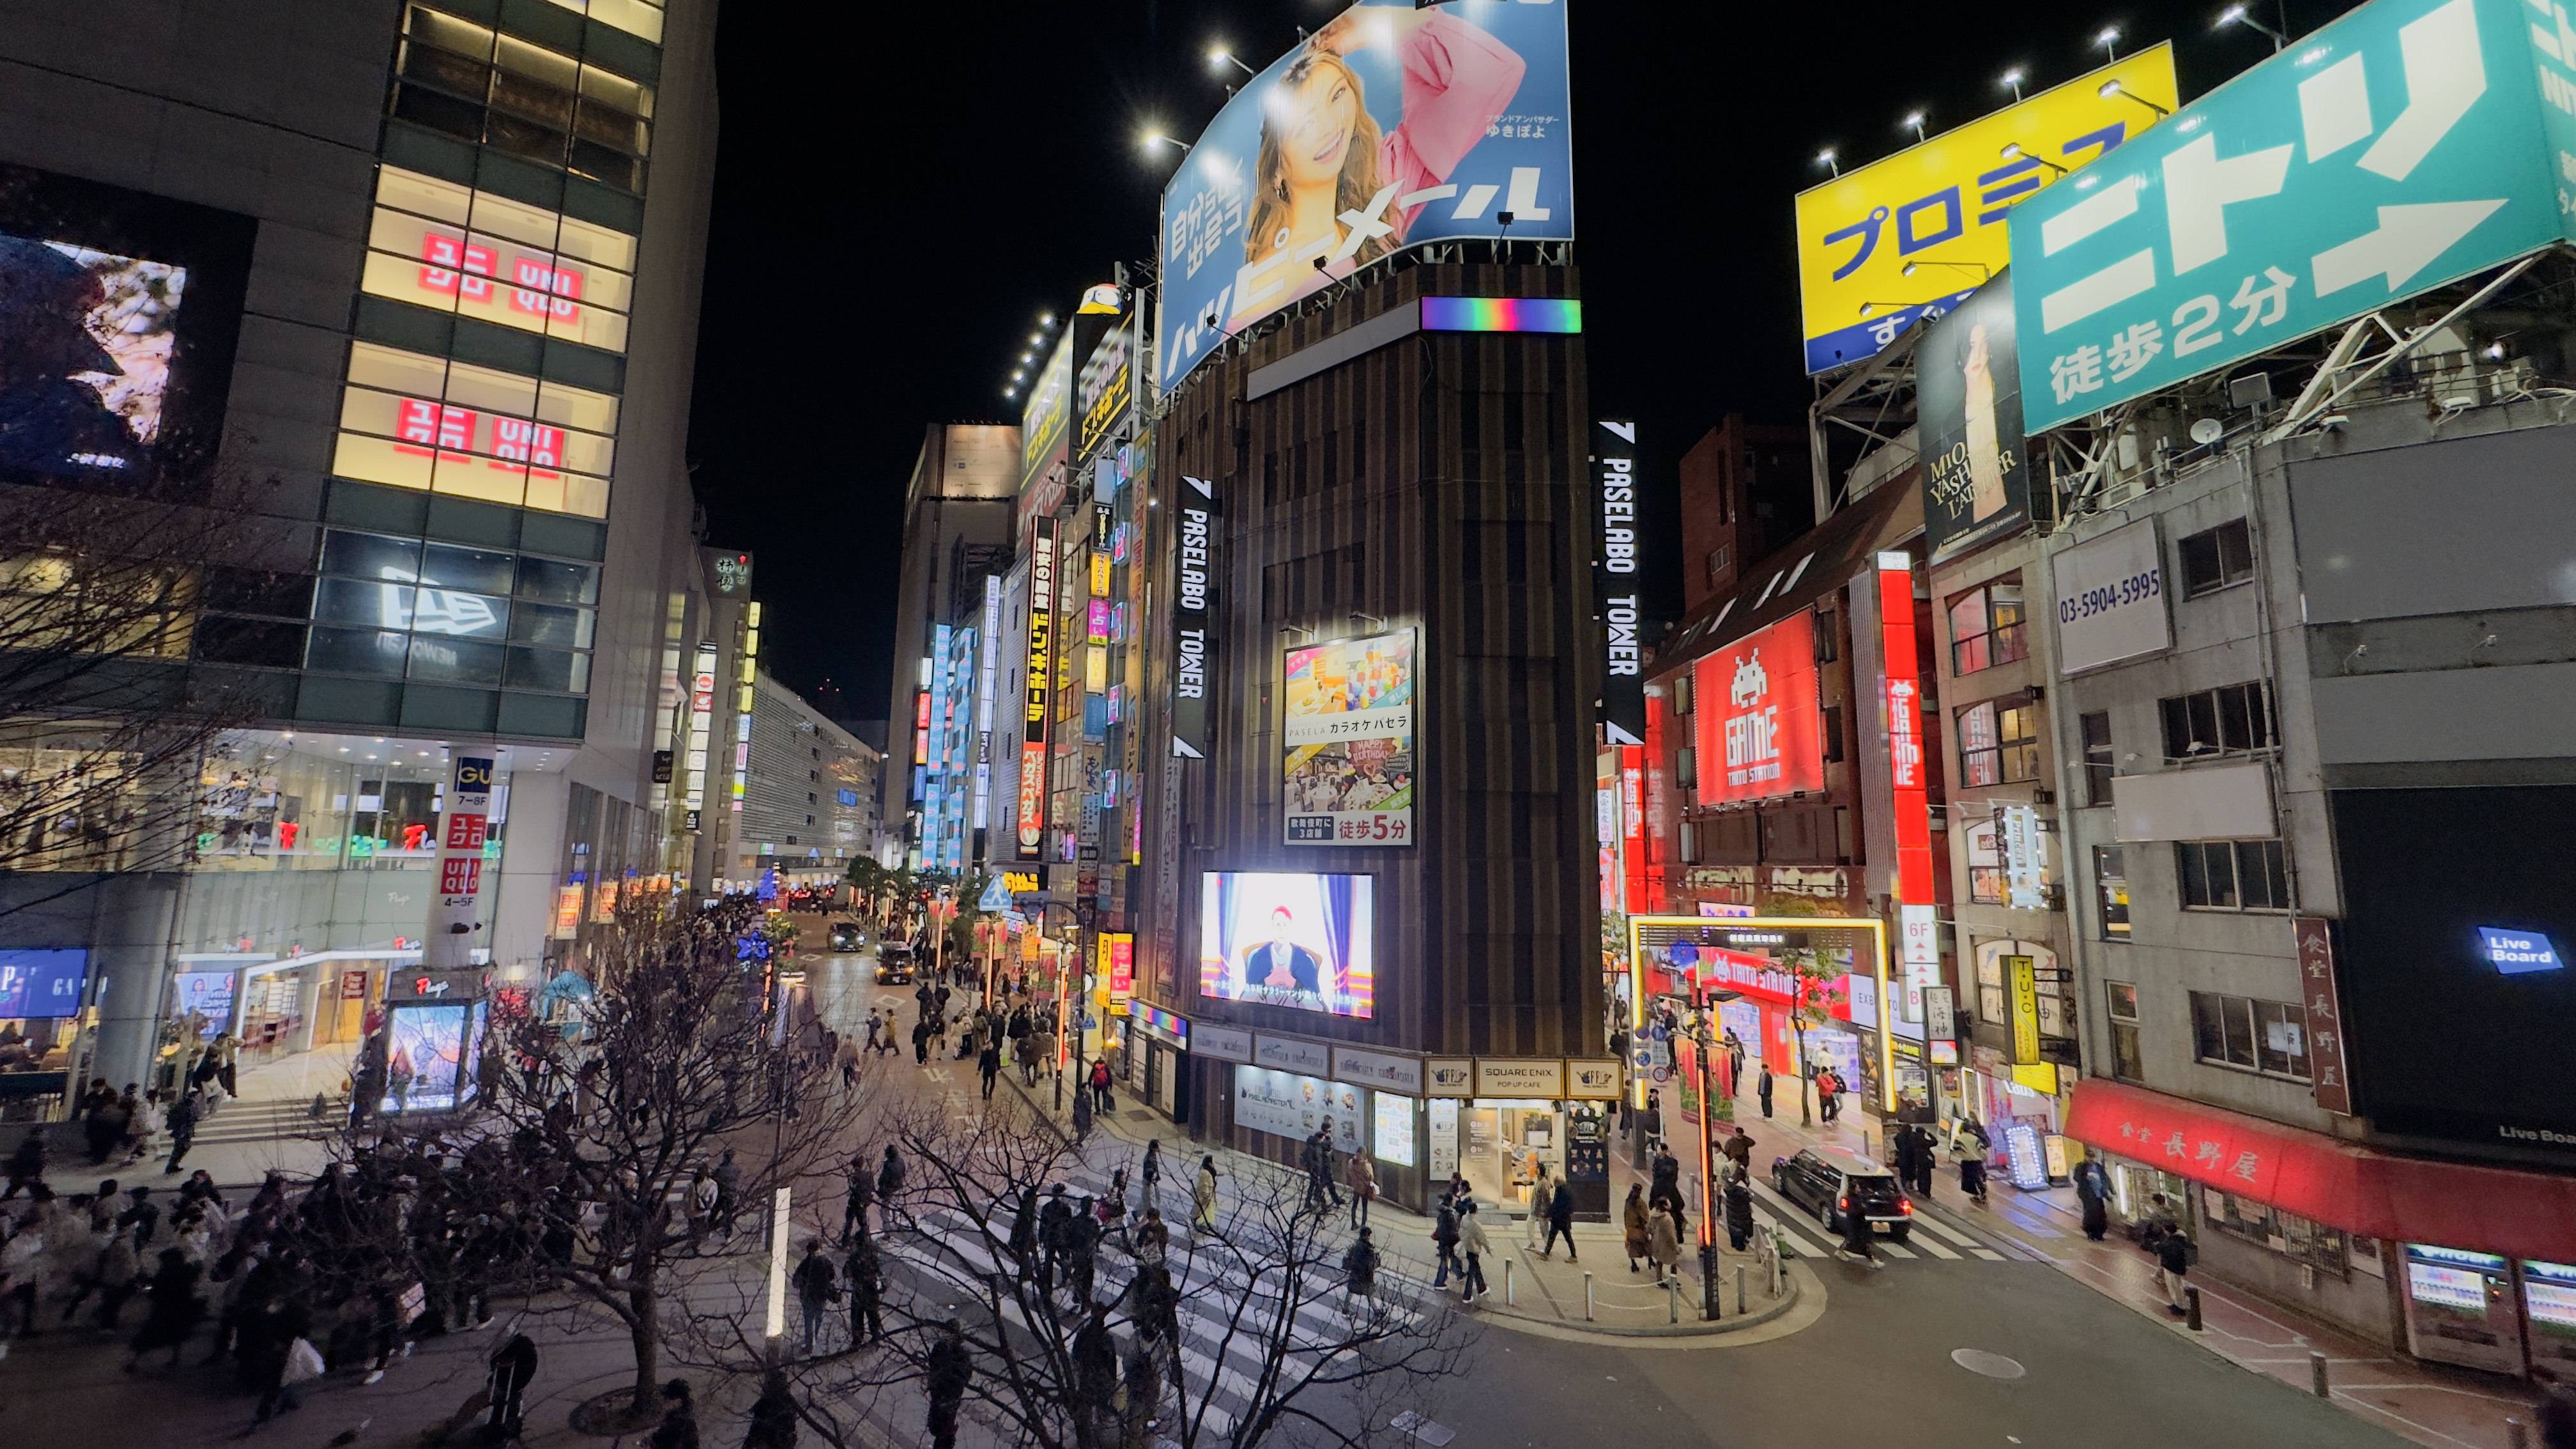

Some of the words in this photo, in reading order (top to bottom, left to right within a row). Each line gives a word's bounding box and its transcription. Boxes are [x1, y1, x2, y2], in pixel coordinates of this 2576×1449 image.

[1485, 125, 1545, 139] ゆきぽよ
[1186, 193, 1243, 281] 出会う
[1166, 167, 1551, 382] ハッピーメール
[2048, 265, 2298, 405] 徒歩2分
[1929, 441, 1966, 483] MIO
[1929, 441, 2000, 507] YASHIRO
[1602, 457, 1636, 574] PASELABO
[1181, 509, 1208, 610] PASELABO
[2059, 569, 2161, 625] 03-5904-5995
[1092, 615, 1106, 634] 占い
[1607, 594, 1639, 676] TOWER
[1179, 629, 1204, 700] TOWER
[1289, 727, 1326, 737] PASELA
[1726, 705, 1779, 769] GAME
[1899, 698, 1916, 785] GAME
[1358, 739, 1385, 751] HAPPY
[459, 766, 492, 785] GU
[1727, 769, 1748, 787] TAITO
[1749, 763, 1780, 783] STATION
[1020, 750, 1037, 824] ベガスベガス
[454, 817, 484, 831] ユニ
[1290, 817, 1331, 829] 歌舞伎町に
[1338, 815, 1407, 841] 徒歩5分
[450, 832, 482, 845] クロ
[447, 862, 478, 875] UNI
[445, 876, 479, 891] QLO
[444, 897, 475, 907] 4-5F
[1910, 923, 1929, 937] 6F
[394, 935, 422, 951] Flags
[2490, 936, 2531, 950] Live
[2492, 949, 2552, 963] Board
[1114, 962, 1130, 988] 占い
[1730, 962, 1757, 986] TAITO
[416, 976, 449, 999] Flags
[1910, 991, 1919, 1004] B
[1933, 1006, 1949, 1039] 海神
[1485, 1068, 1528, 1077] SQUARE
[1656, 1070, 1666, 1079] 30
[1248, 1092, 1261, 1104] PIXEL
[2499, 1124, 2538, 1140] Live
[2540, 1130, 2576, 1144] Boa
[2119, 1121, 2152, 1143] 食堂
[2162, 1131, 2259, 1183] 長野屋
